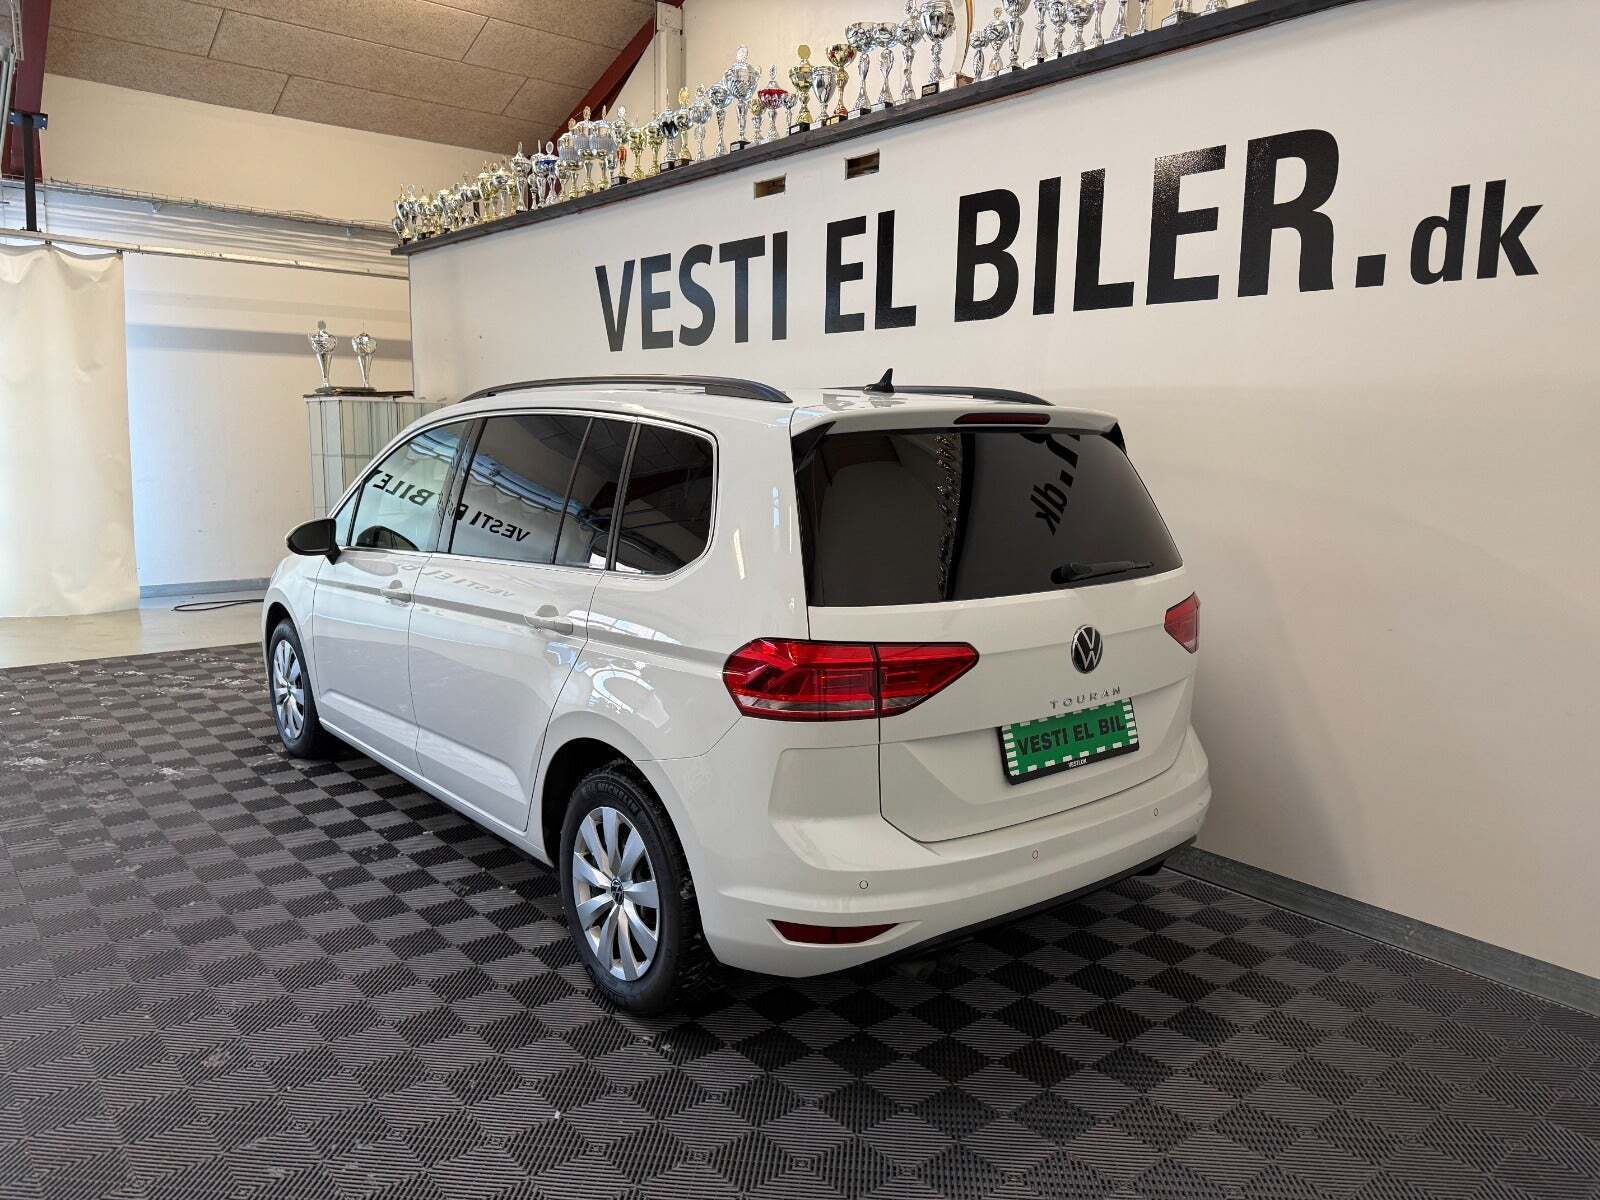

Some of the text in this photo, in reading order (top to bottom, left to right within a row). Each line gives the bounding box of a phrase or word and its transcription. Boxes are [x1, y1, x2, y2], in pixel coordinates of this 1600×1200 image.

[595, 231, 788, 353] VESTI
[824, 210, 917, 334] EL
[1050, 685, 1122, 710] TOURAN
[1016, 715, 1126, 756] VESTI EL BIL
